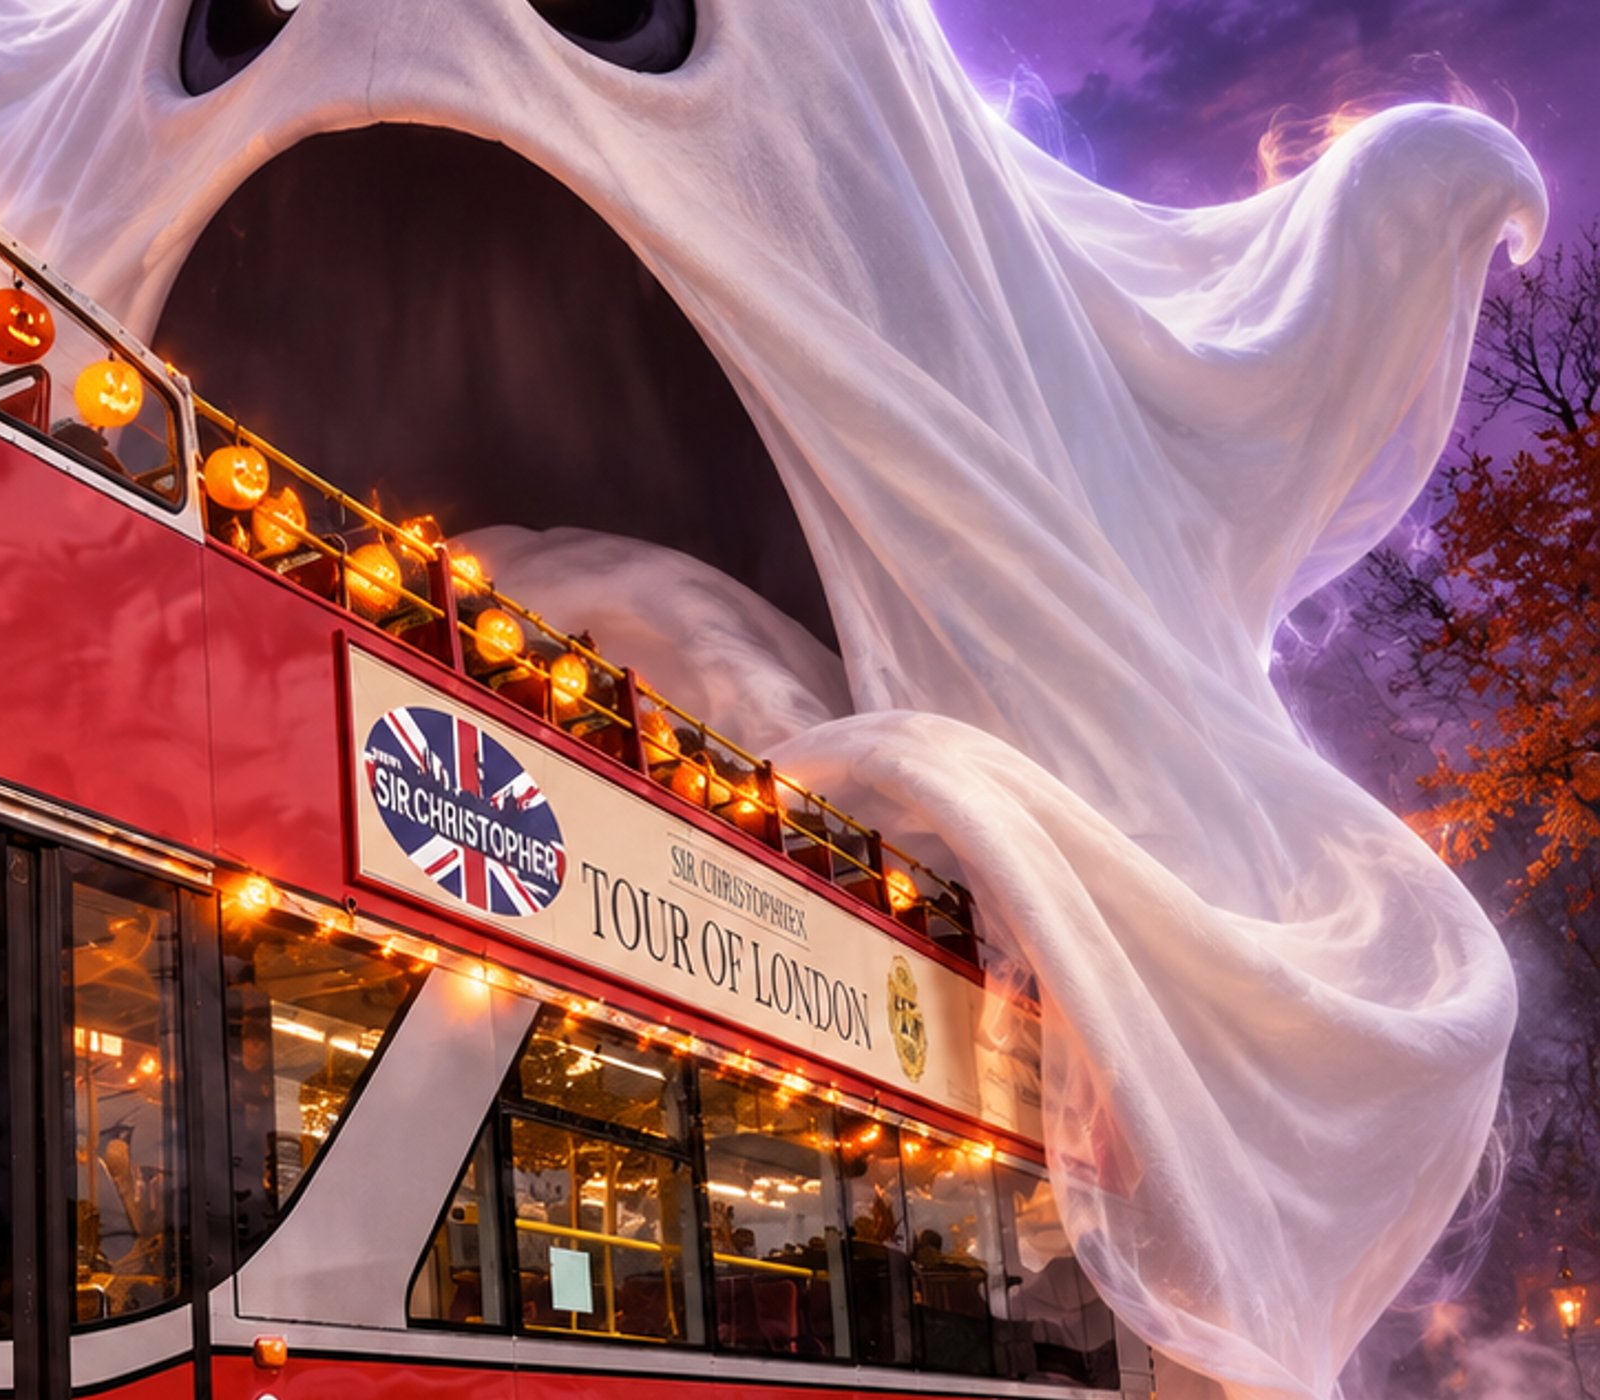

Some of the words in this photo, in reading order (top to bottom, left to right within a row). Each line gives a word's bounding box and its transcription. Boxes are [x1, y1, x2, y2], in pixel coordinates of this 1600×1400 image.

[582, 861, 695, 976] TOUR
[702, 920, 743, 994] OF
[751, 940, 872, 1050] LONDON
